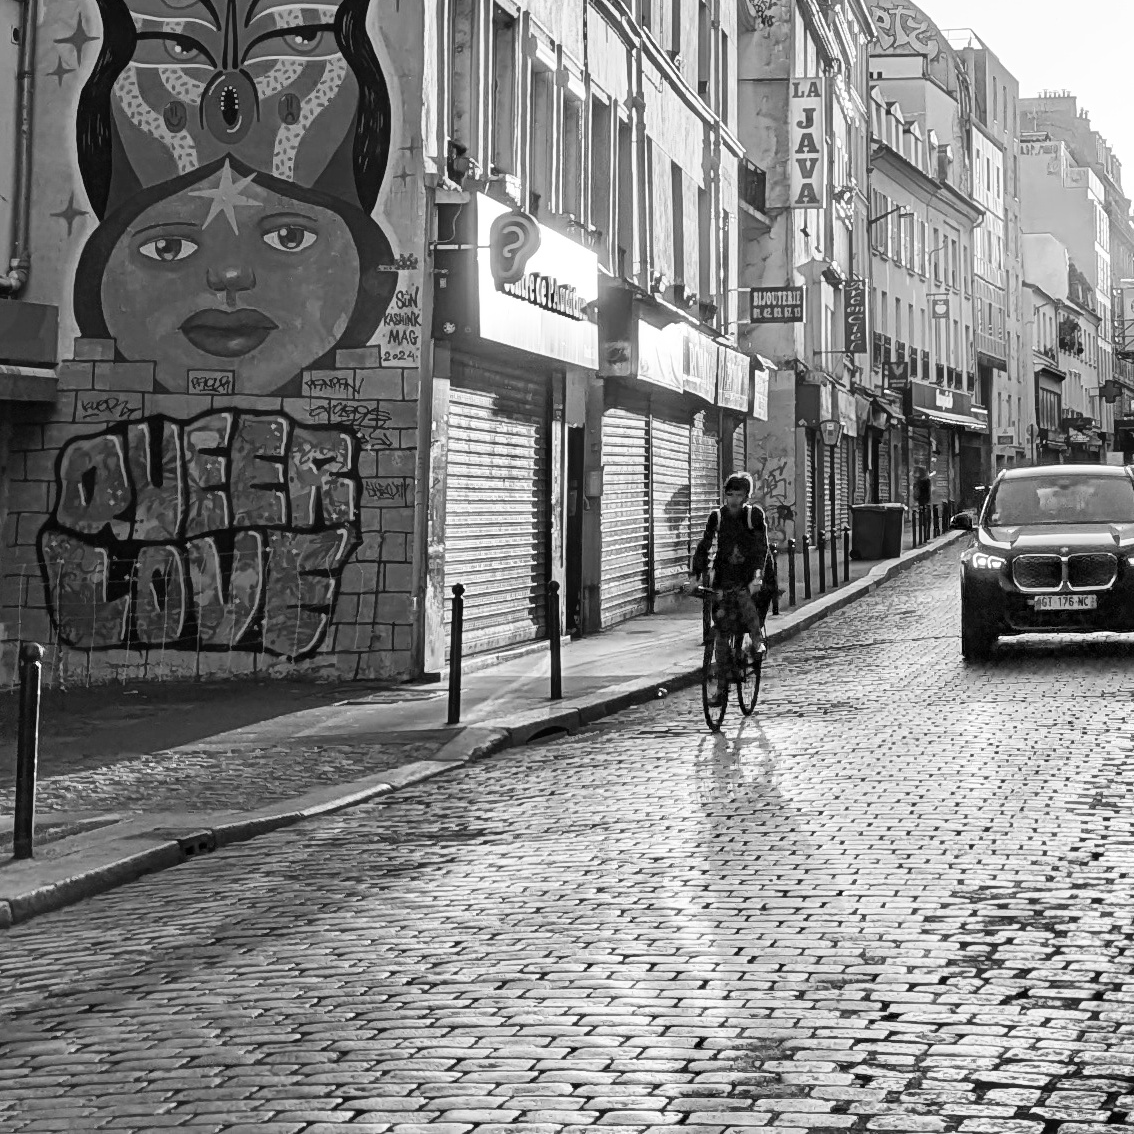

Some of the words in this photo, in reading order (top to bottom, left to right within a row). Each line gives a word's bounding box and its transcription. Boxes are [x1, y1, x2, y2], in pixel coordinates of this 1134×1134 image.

[792, 81, 821, 98] LA
[794, 107, 820, 204] JAVA
[753, 290, 801, 306] BIJOUTERIE
[388, 329, 419, 346] MAG
[382, 350, 415, 362] 2024
[54, 406, 362, 542] QUEER
[37, 526, 362, 661] LOVE
